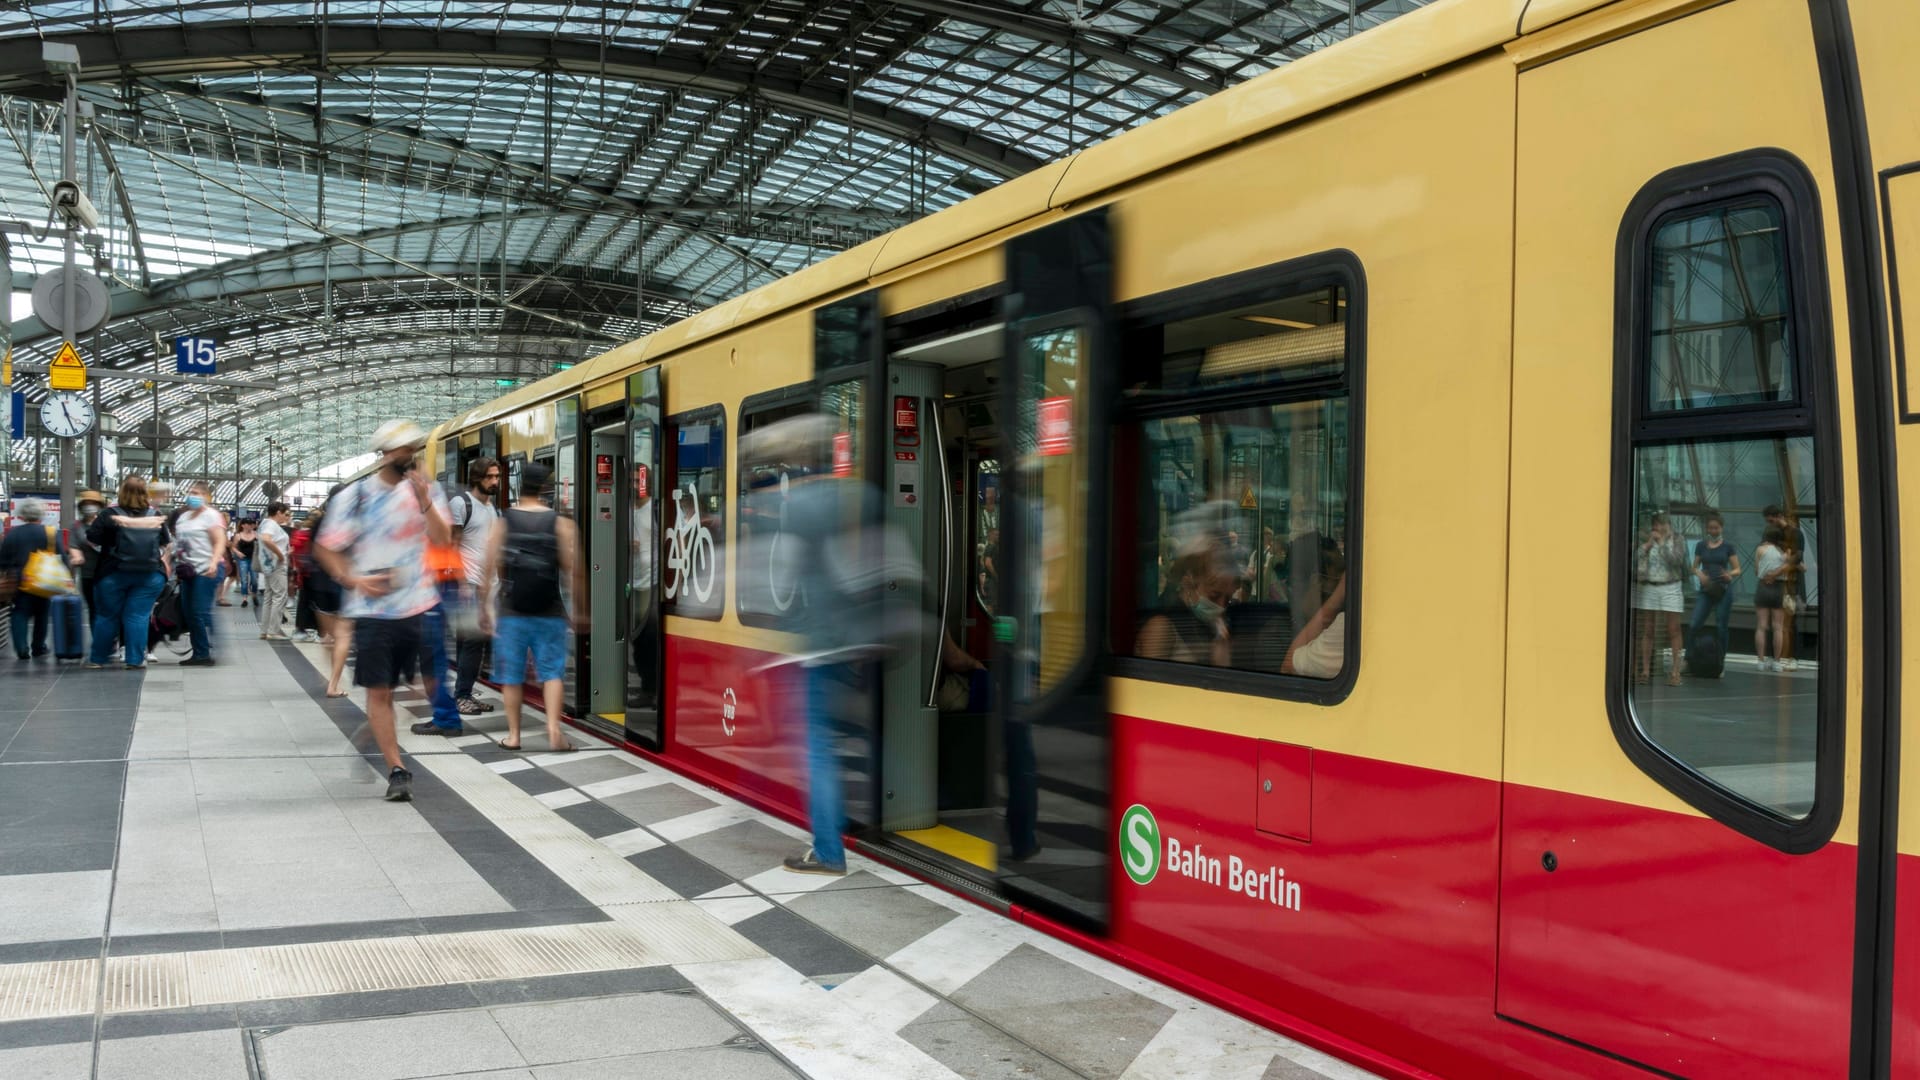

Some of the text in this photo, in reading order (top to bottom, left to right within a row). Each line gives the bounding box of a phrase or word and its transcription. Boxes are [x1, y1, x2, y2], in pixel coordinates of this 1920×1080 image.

[182, 338, 215, 366] 15
[1127, 813, 1301, 912] S Bahn Berlin
